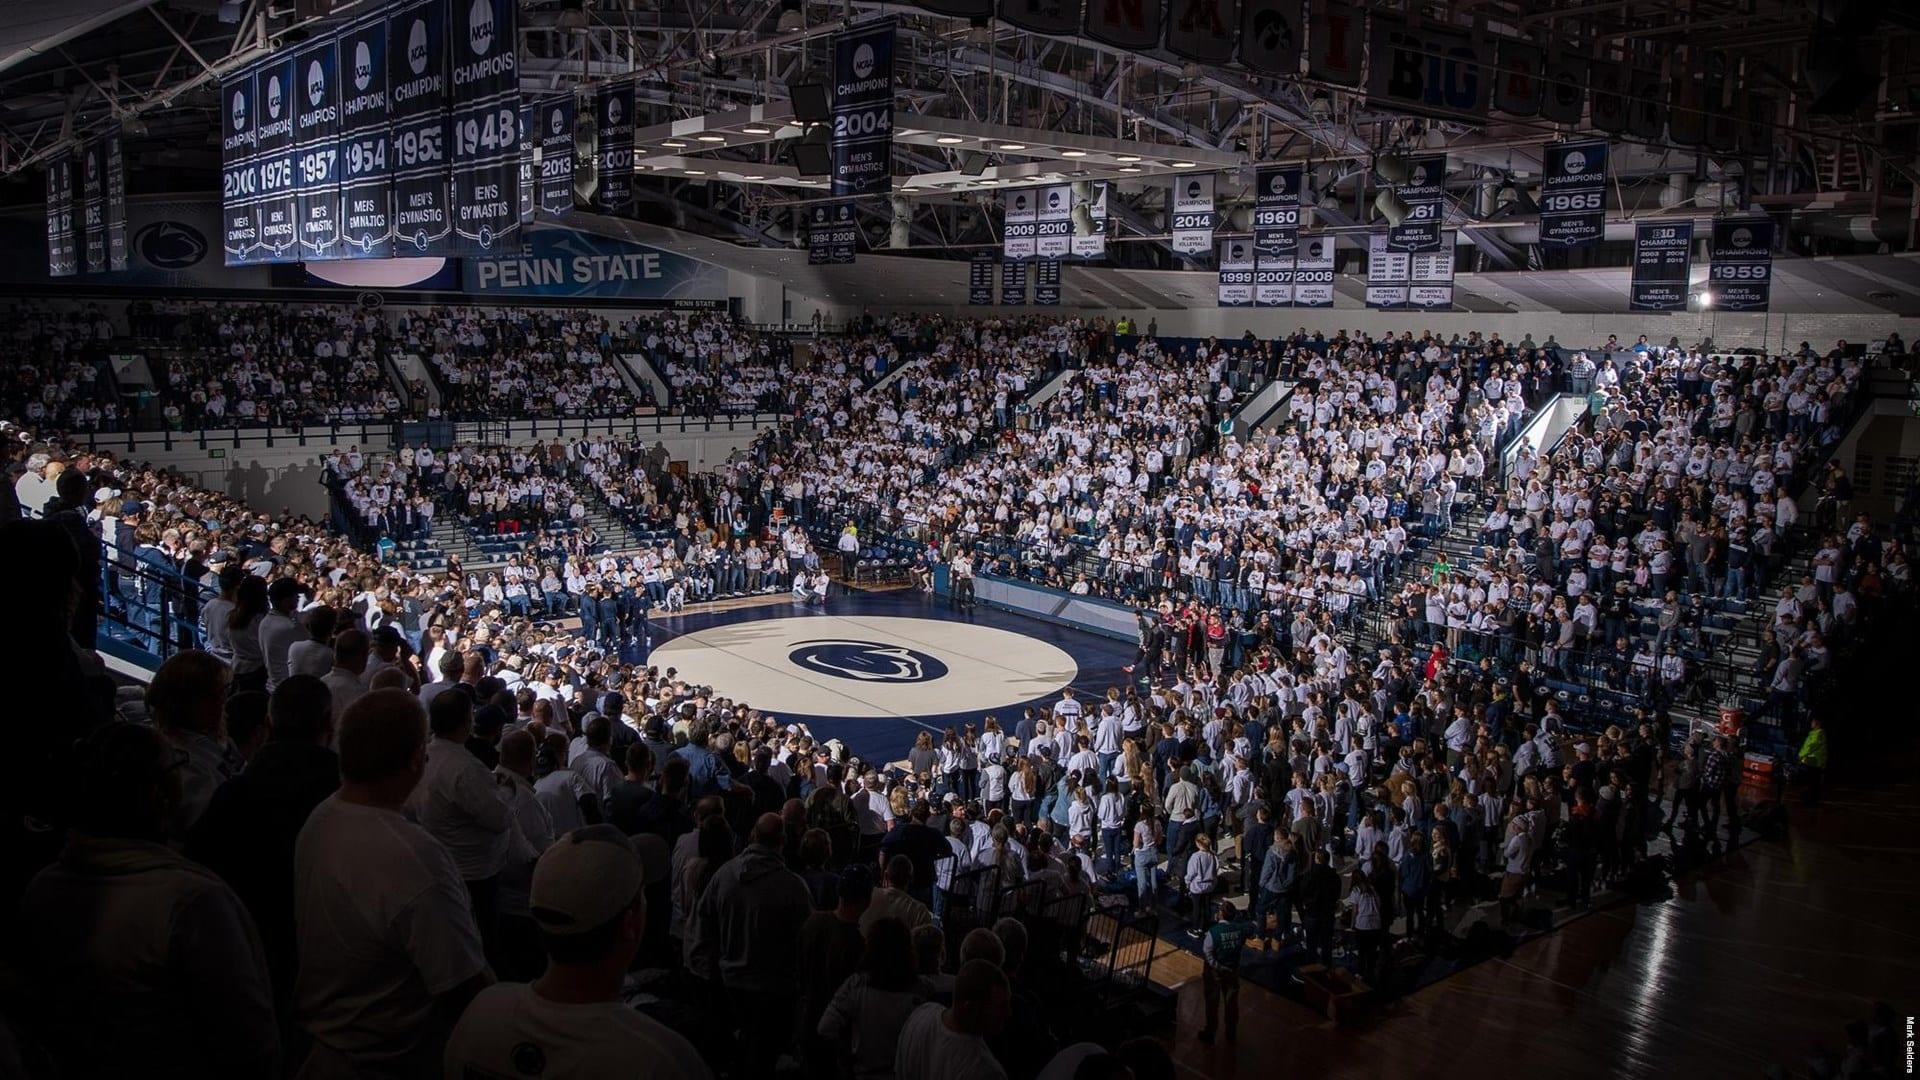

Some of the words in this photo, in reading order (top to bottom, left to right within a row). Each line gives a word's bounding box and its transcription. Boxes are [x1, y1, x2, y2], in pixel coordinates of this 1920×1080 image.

[838, 78, 889, 96] CHAMPIONS
[300, 106, 336, 129] CHAMPIOS
[833, 109, 892, 137] 2004
[456, 109, 516, 156] 1948
[346, 138, 386, 175] 1954
[599, 149, 633, 169] 2007
[850, 152, 873, 163] MEN'S
[300, 150, 336, 184] 1957
[541, 156, 572, 178] 2013
[839, 162, 885, 175] GYMNASTICS
[260, 158, 292, 191] 1976
[1548, 172, 1603, 185] CHAMPIONS
[224, 167, 256, 198] 2000
[409, 191, 433, 208] MEN'S
[1177, 199, 1211, 207] CHAMPIONS
[1259, 193, 1299, 202] CHAMPIONS
[1545, 193, 1601, 211] 1965
[1174, 215, 1211, 228] 2014
[1256, 211, 1297, 225] 1960
[1005, 223, 1036, 236] 2009
[1038, 222, 1068, 235] 2010
[1549, 226, 1597, 235] GYMNASTICS
[1640, 238, 1688, 247] CHAMPIONS
[1715, 247, 1769, 256] CHAMPIONS
[478, 257, 564, 289] PENN
[572, 252, 663, 284] STATE
[1258, 272, 1293, 282] 2007
[1297, 271, 1333, 282] 2008
[1713, 265, 1767, 279] 1959
[1221, 272, 1253, 283] 1999
[674, 300, 694, 308] PENN
[694, 300, 716, 308] STATE
